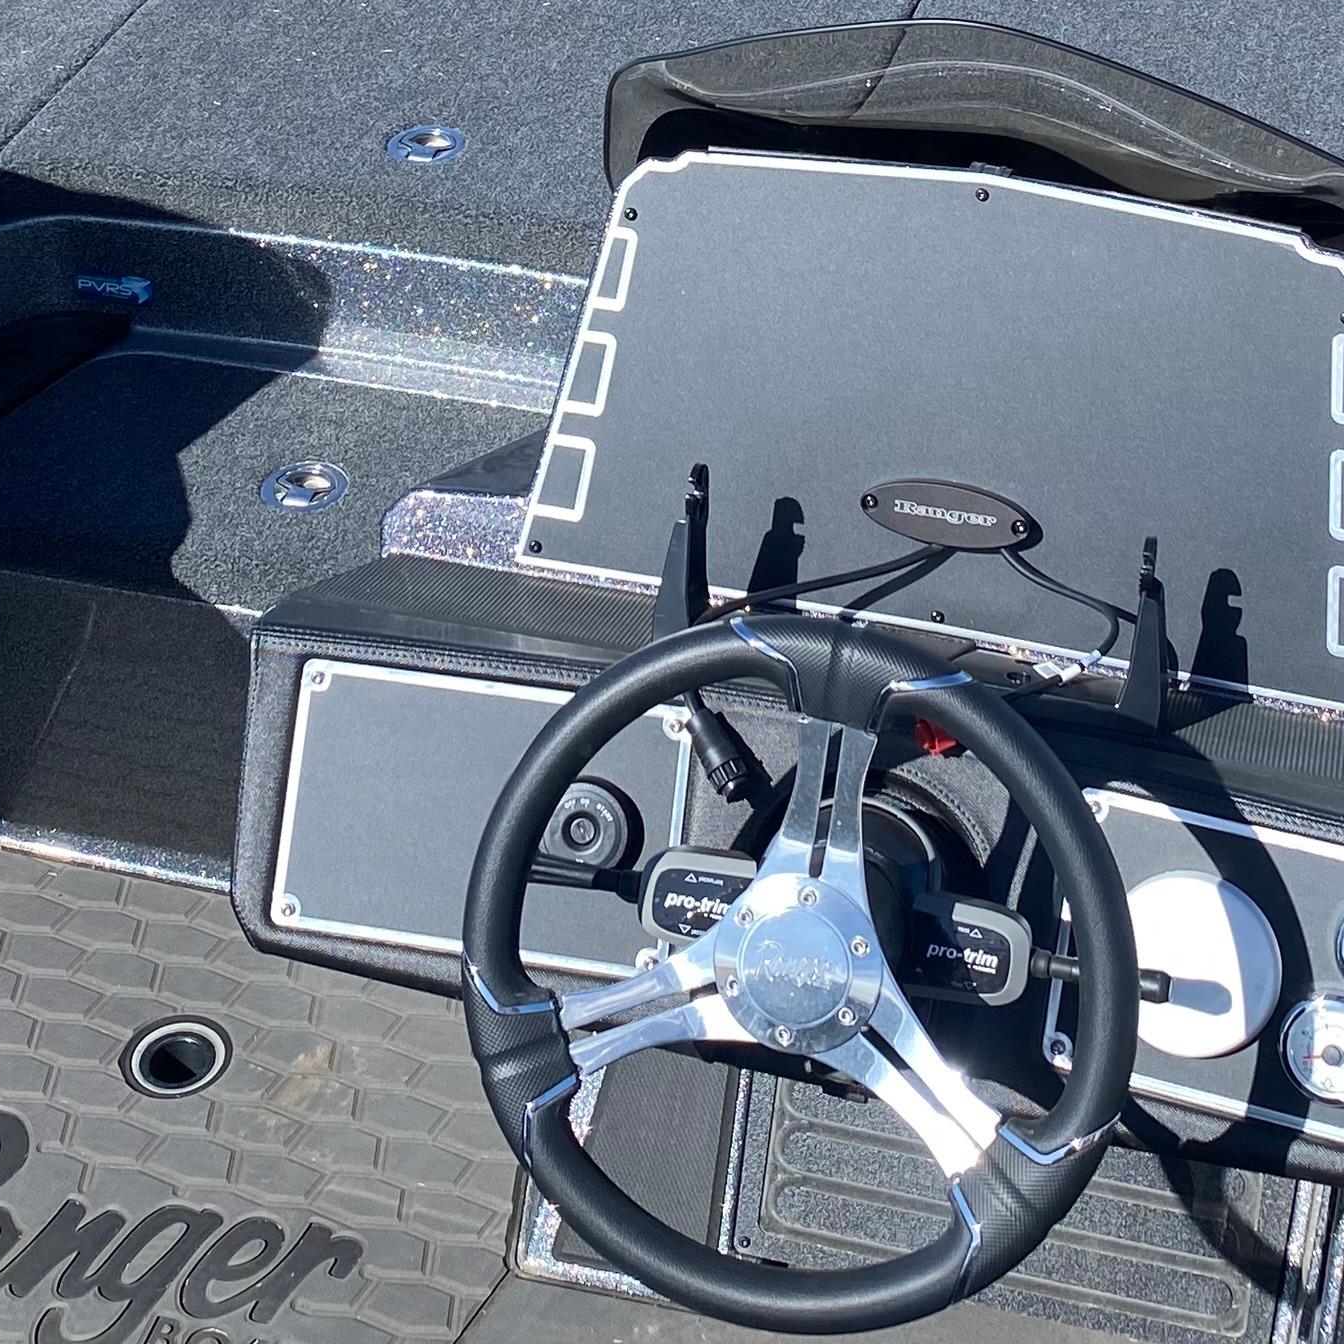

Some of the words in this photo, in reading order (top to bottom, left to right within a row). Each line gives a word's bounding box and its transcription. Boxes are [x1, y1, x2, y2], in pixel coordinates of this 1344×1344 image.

[78, 279, 132, 296] PVRS
[894, 499, 997, 527] Ranger
[926, 944, 999, 969] pro-trim
